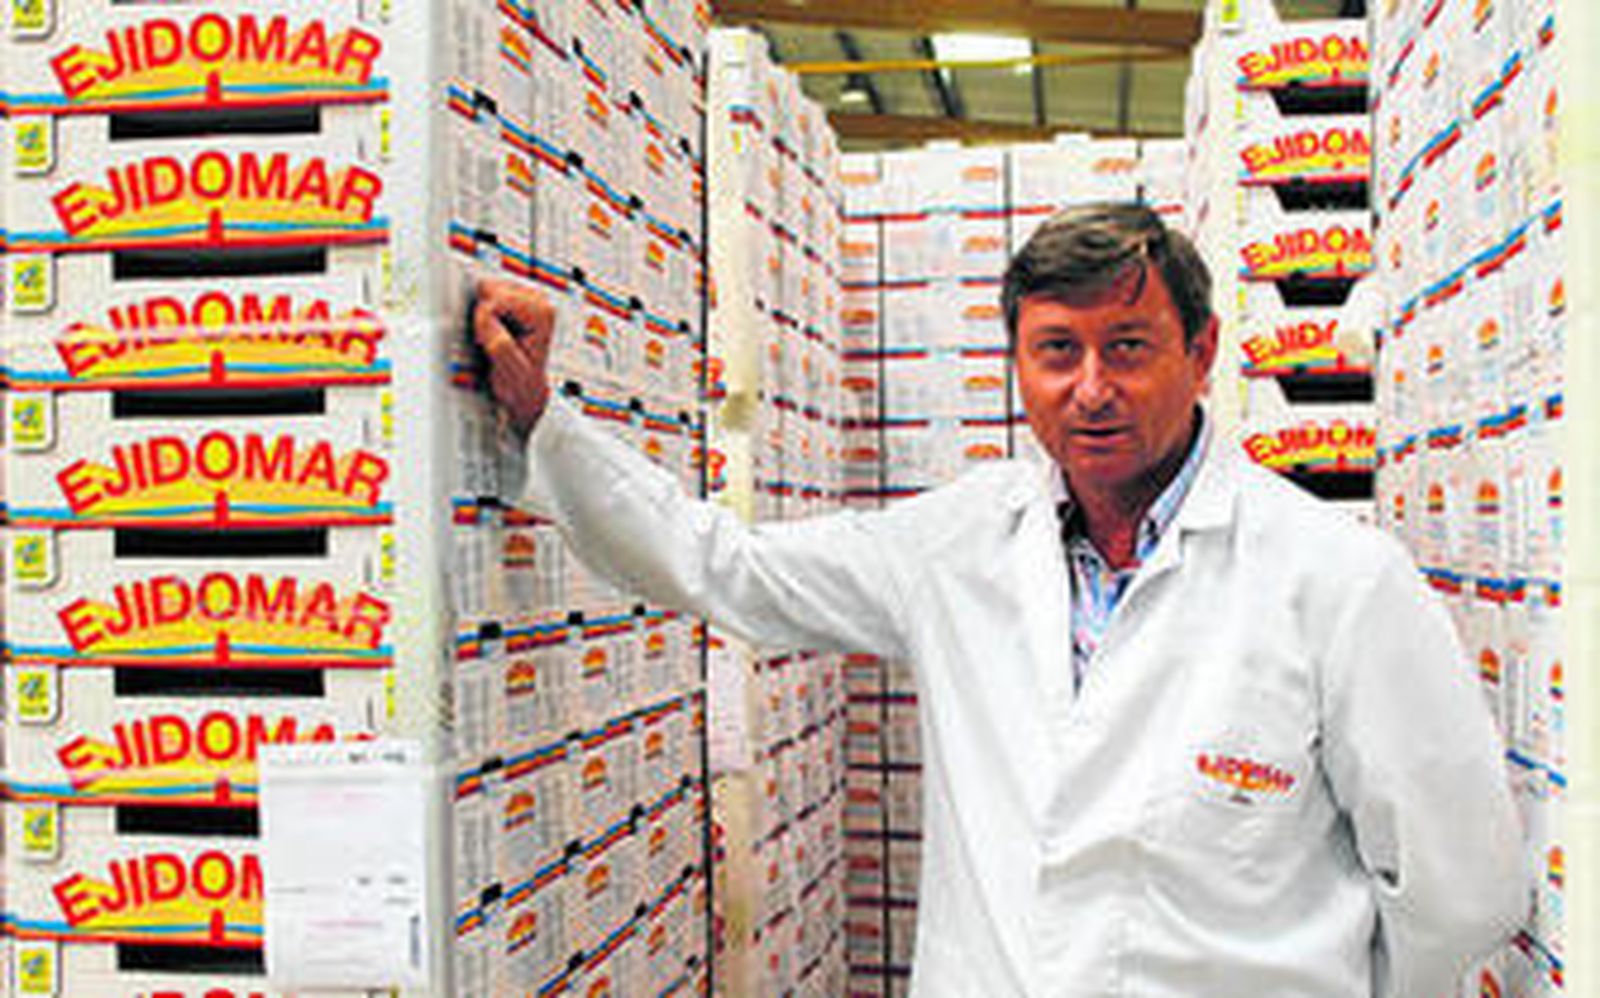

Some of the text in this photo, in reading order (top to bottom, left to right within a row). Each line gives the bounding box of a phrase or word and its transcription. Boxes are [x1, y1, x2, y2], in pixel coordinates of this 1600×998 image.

[49, 13, 382, 99] EJIDOMAR
[51, 151, 383, 237] EJIDOMAR
[55, 291, 386, 378] EJIDOMAR
[55, 431, 391, 514] EJIDOMAR
[57, 572, 391, 652] EJIDOMAR
